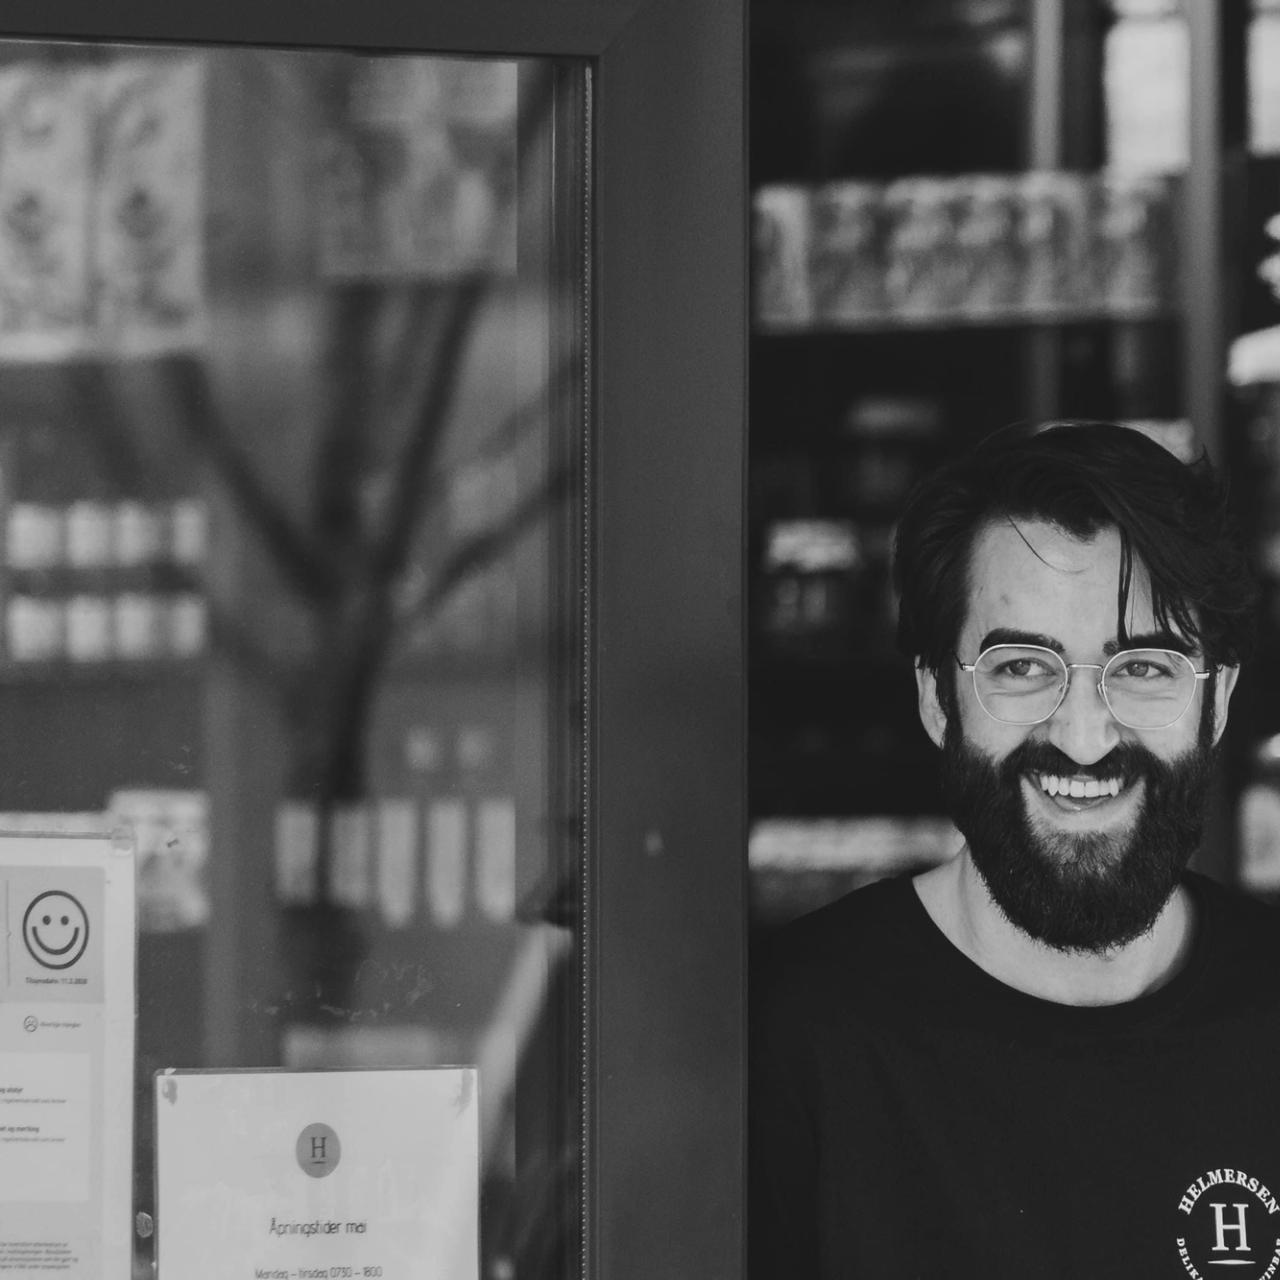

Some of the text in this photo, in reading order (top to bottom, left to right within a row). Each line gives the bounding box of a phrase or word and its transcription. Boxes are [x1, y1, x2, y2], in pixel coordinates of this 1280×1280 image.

[311, 1136, 327, 1158] H
[1178, 1168, 1280, 1215] HELMERSEN
[269, 1217, 342, 1238] Åpningstider
[1209, 1203, 1251, 1251] H
